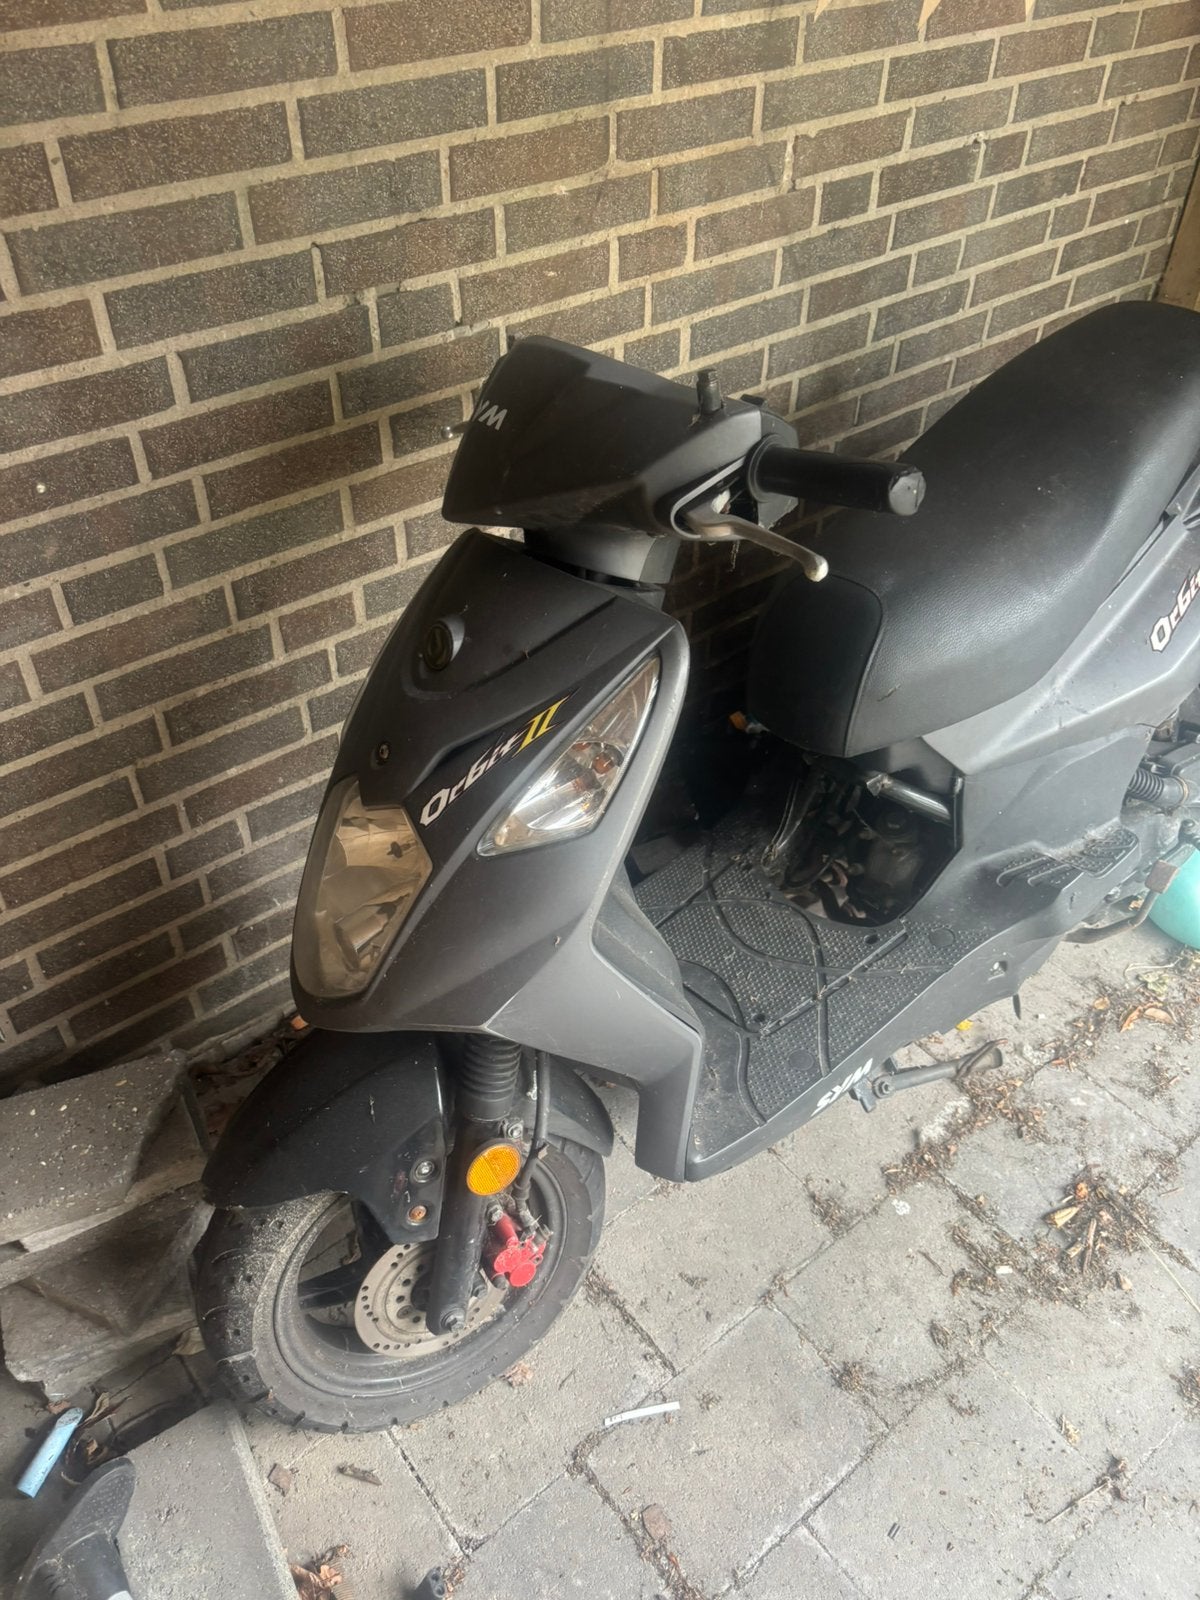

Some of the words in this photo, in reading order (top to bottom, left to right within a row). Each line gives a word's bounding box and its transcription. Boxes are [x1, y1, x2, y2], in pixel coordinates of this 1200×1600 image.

[472, 400, 508, 431] YM
[419, 730, 527, 827] Orbit
[810, 1057, 874, 1117] SYM
